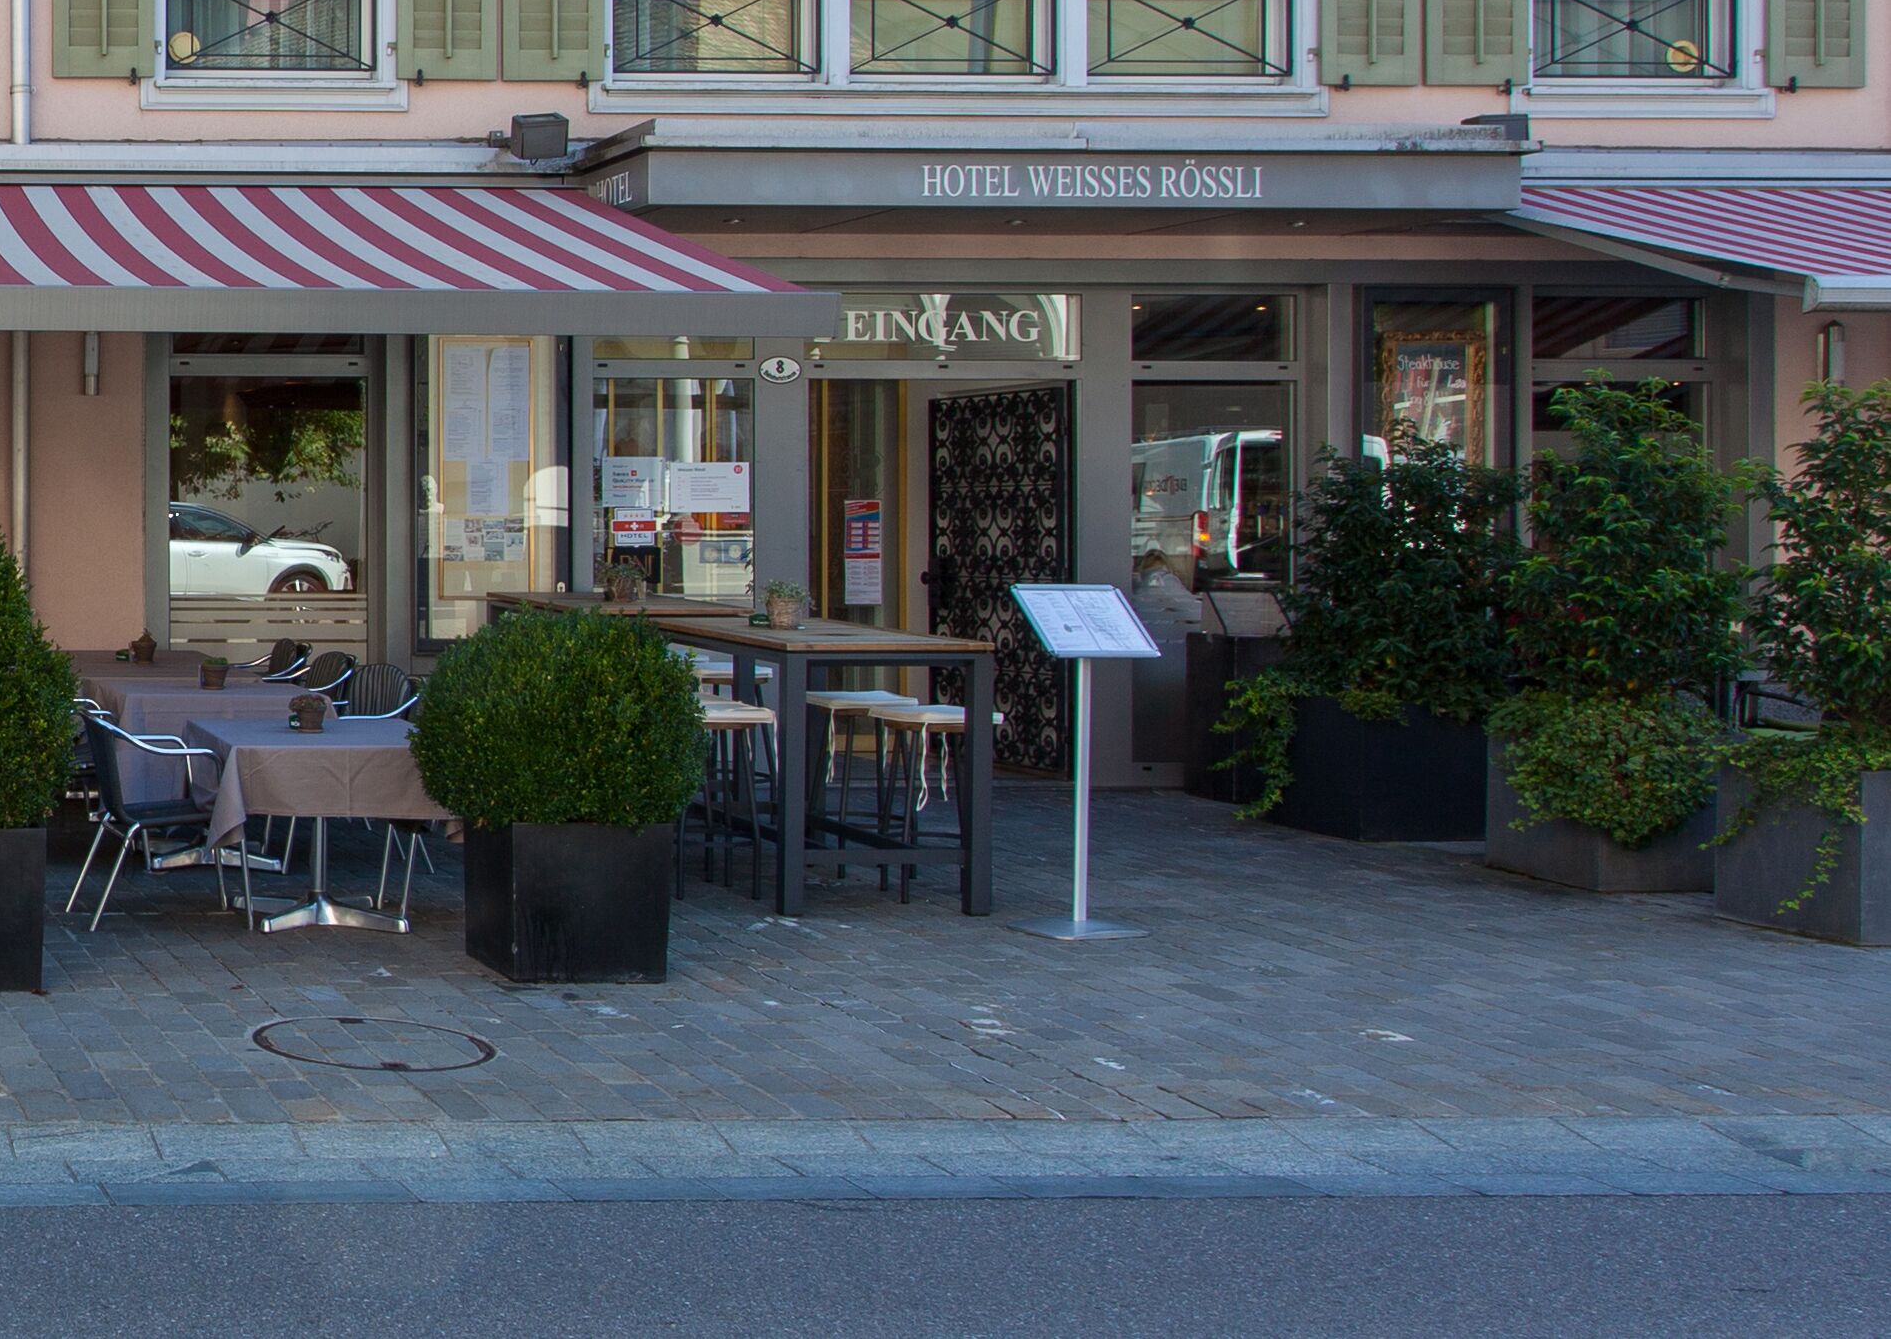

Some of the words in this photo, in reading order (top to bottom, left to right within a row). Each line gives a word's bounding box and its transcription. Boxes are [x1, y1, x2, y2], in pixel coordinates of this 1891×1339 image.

[596, 172, 632, 206] HOTEL
[922, 165, 1019, 197] HOTEL
[1027, 165, 1151, 198] WEISSES
[1159, 159, 1263, 198] RÖSSLI
[845, 311, 1041, 341] EINGANG
[776, 360, 784, 373] 8
[1398, 354, 1460, 370] Steakhouse
